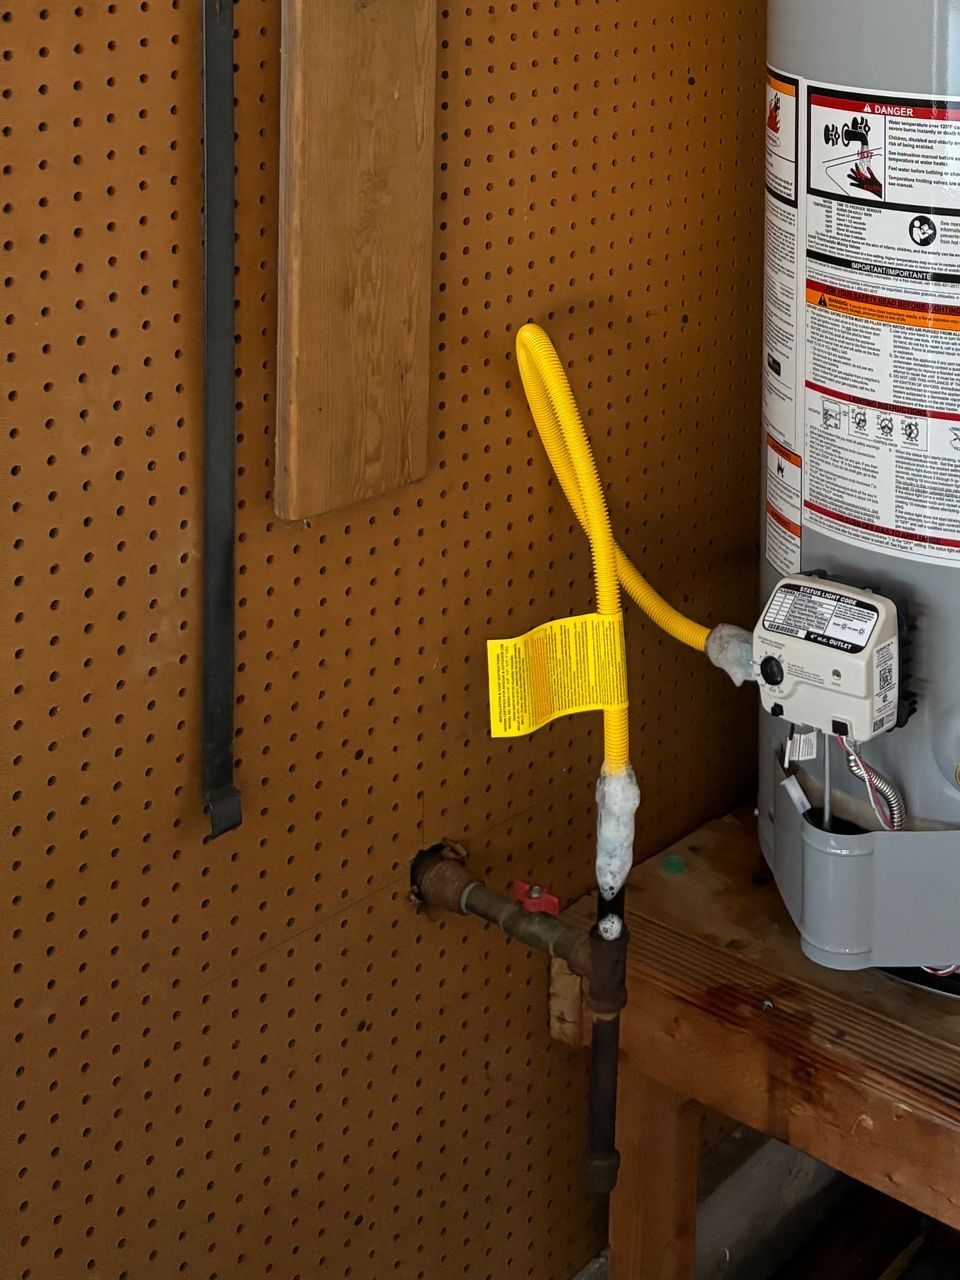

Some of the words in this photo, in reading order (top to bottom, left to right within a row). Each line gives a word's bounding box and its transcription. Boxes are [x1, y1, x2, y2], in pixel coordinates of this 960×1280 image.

[875, 104, 913, 117] DANGER
[800, 586, 820, 596] STATUS
[822, 591, 839, 600] LIGHT
[840, 596, 857, 605] CODE
[829, 639, 852, 650] OUTLET
